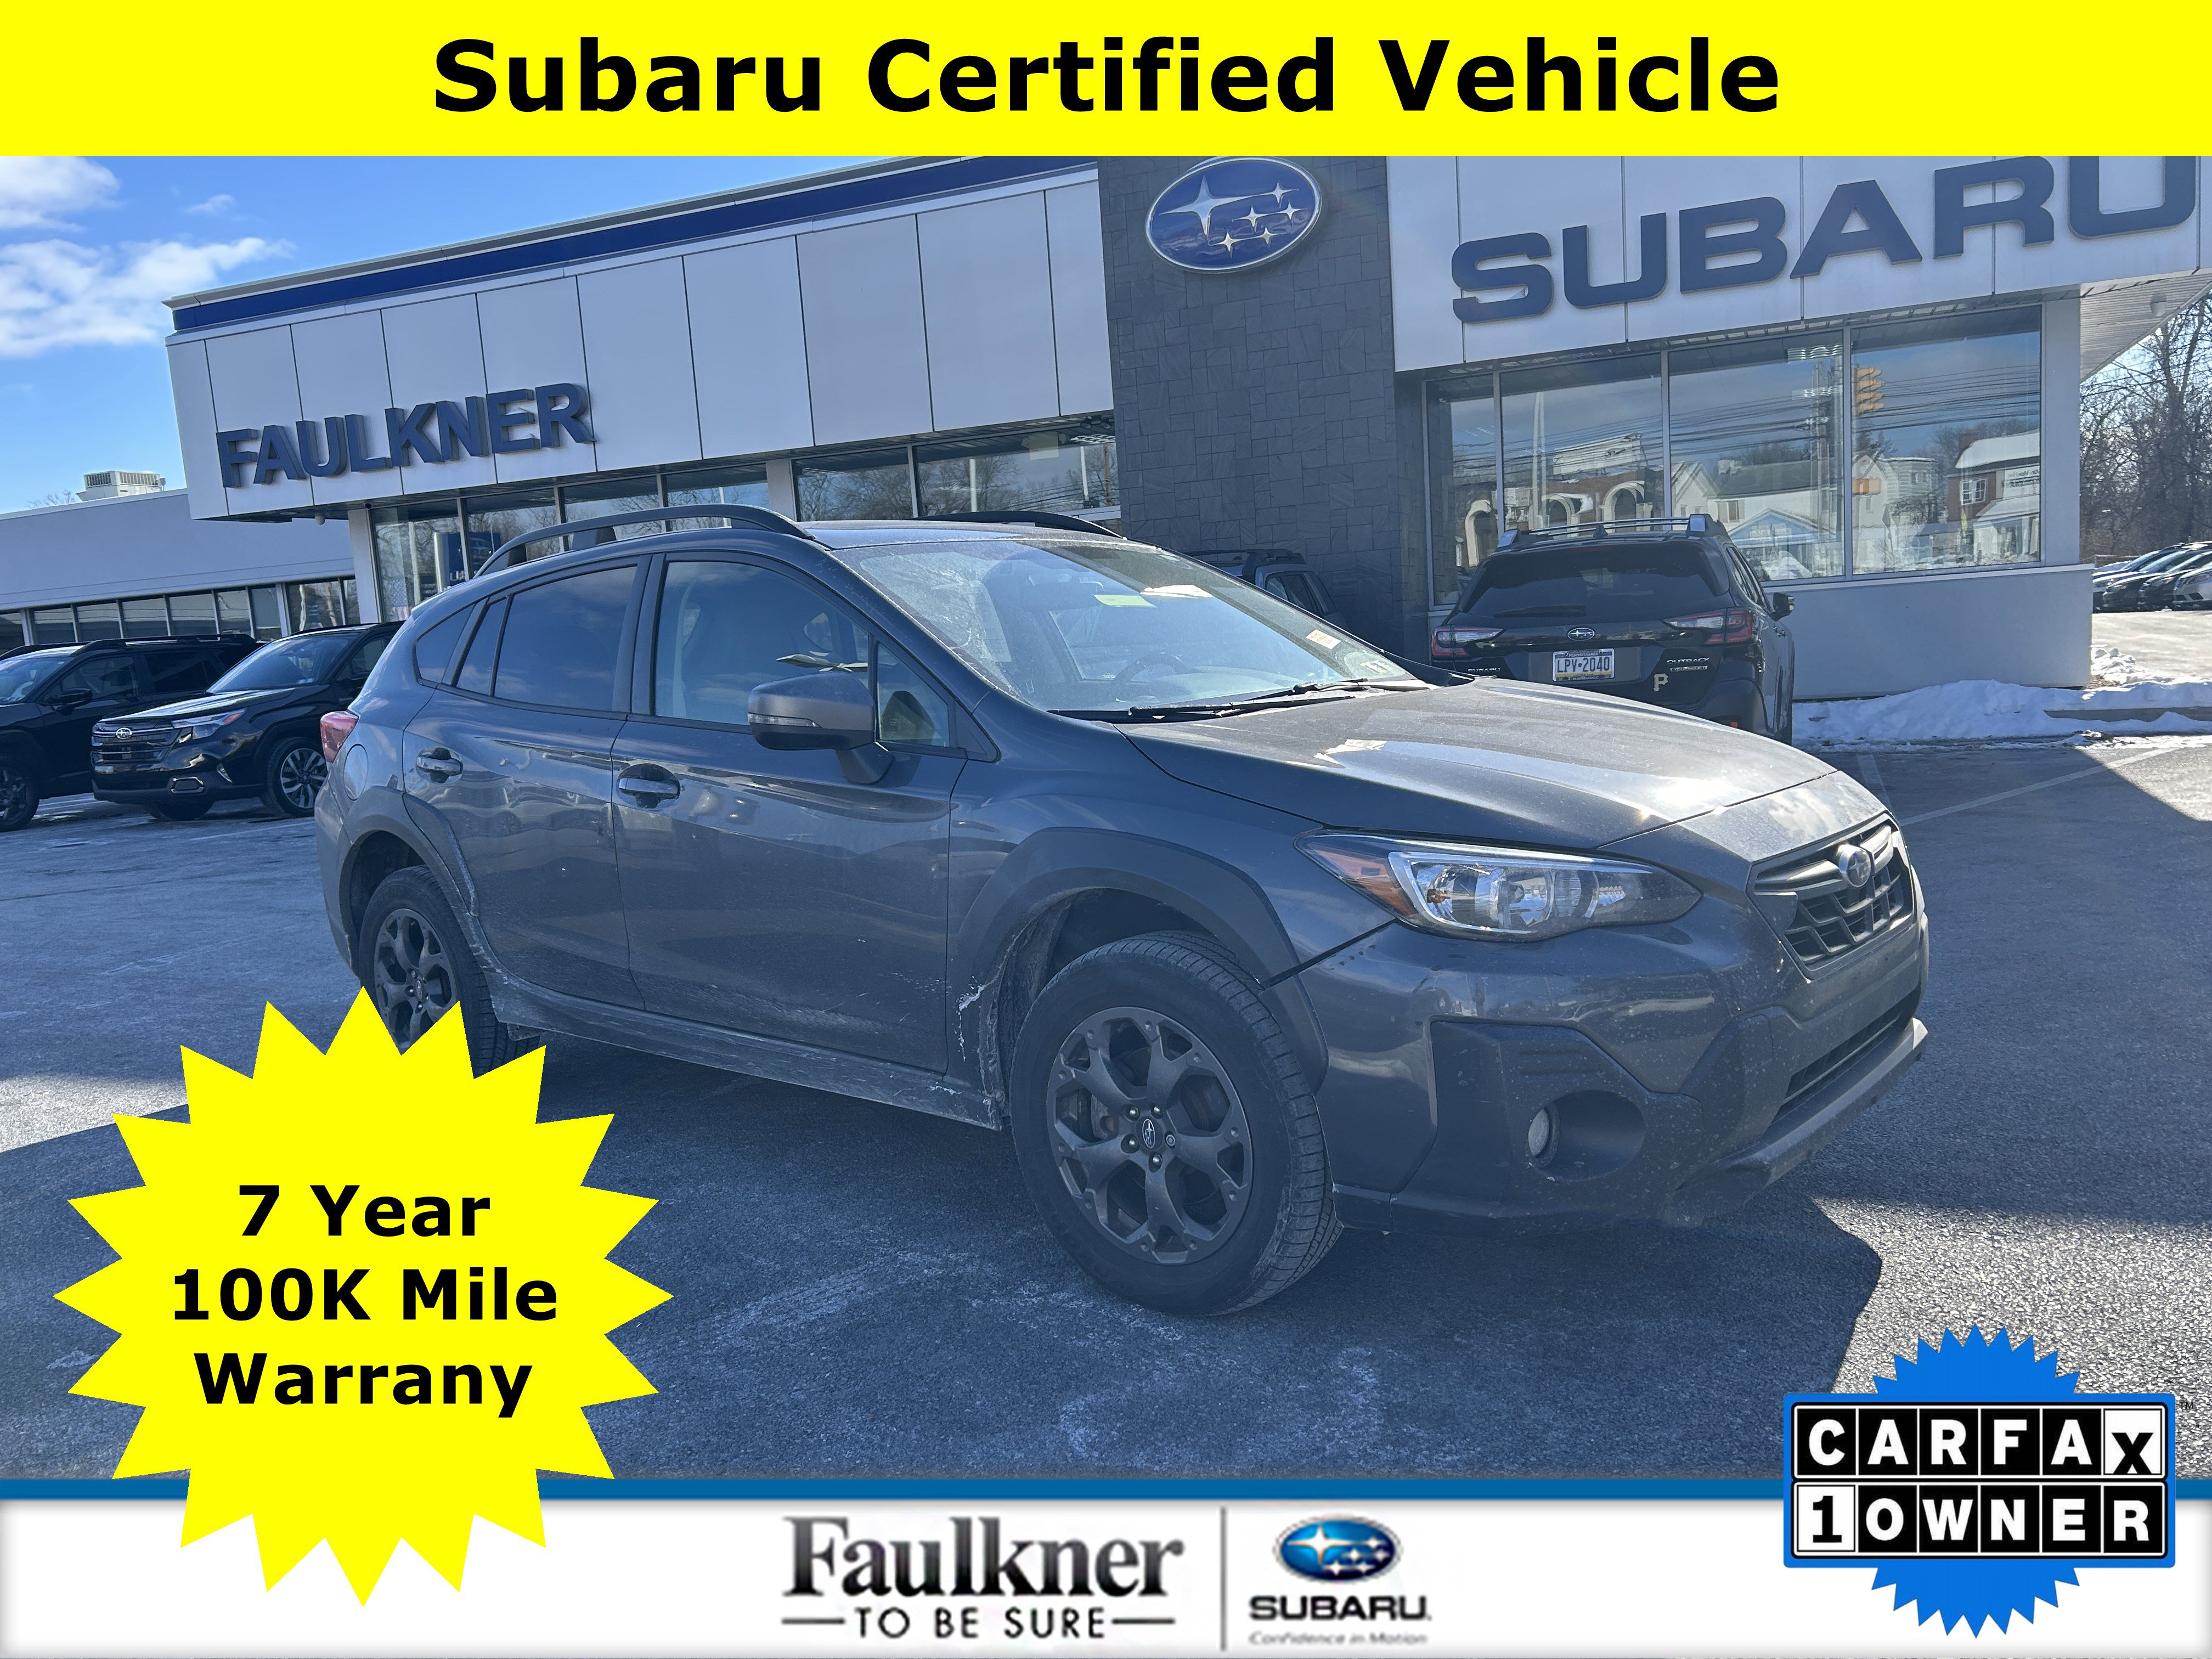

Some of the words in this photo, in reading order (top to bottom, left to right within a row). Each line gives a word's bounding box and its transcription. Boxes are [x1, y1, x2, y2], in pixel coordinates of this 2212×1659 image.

[1452, 156, 2196, 325] SUBARU
[216, 382, 596, 488] FAULKNER
[1653, 673, 1668, 692] P
